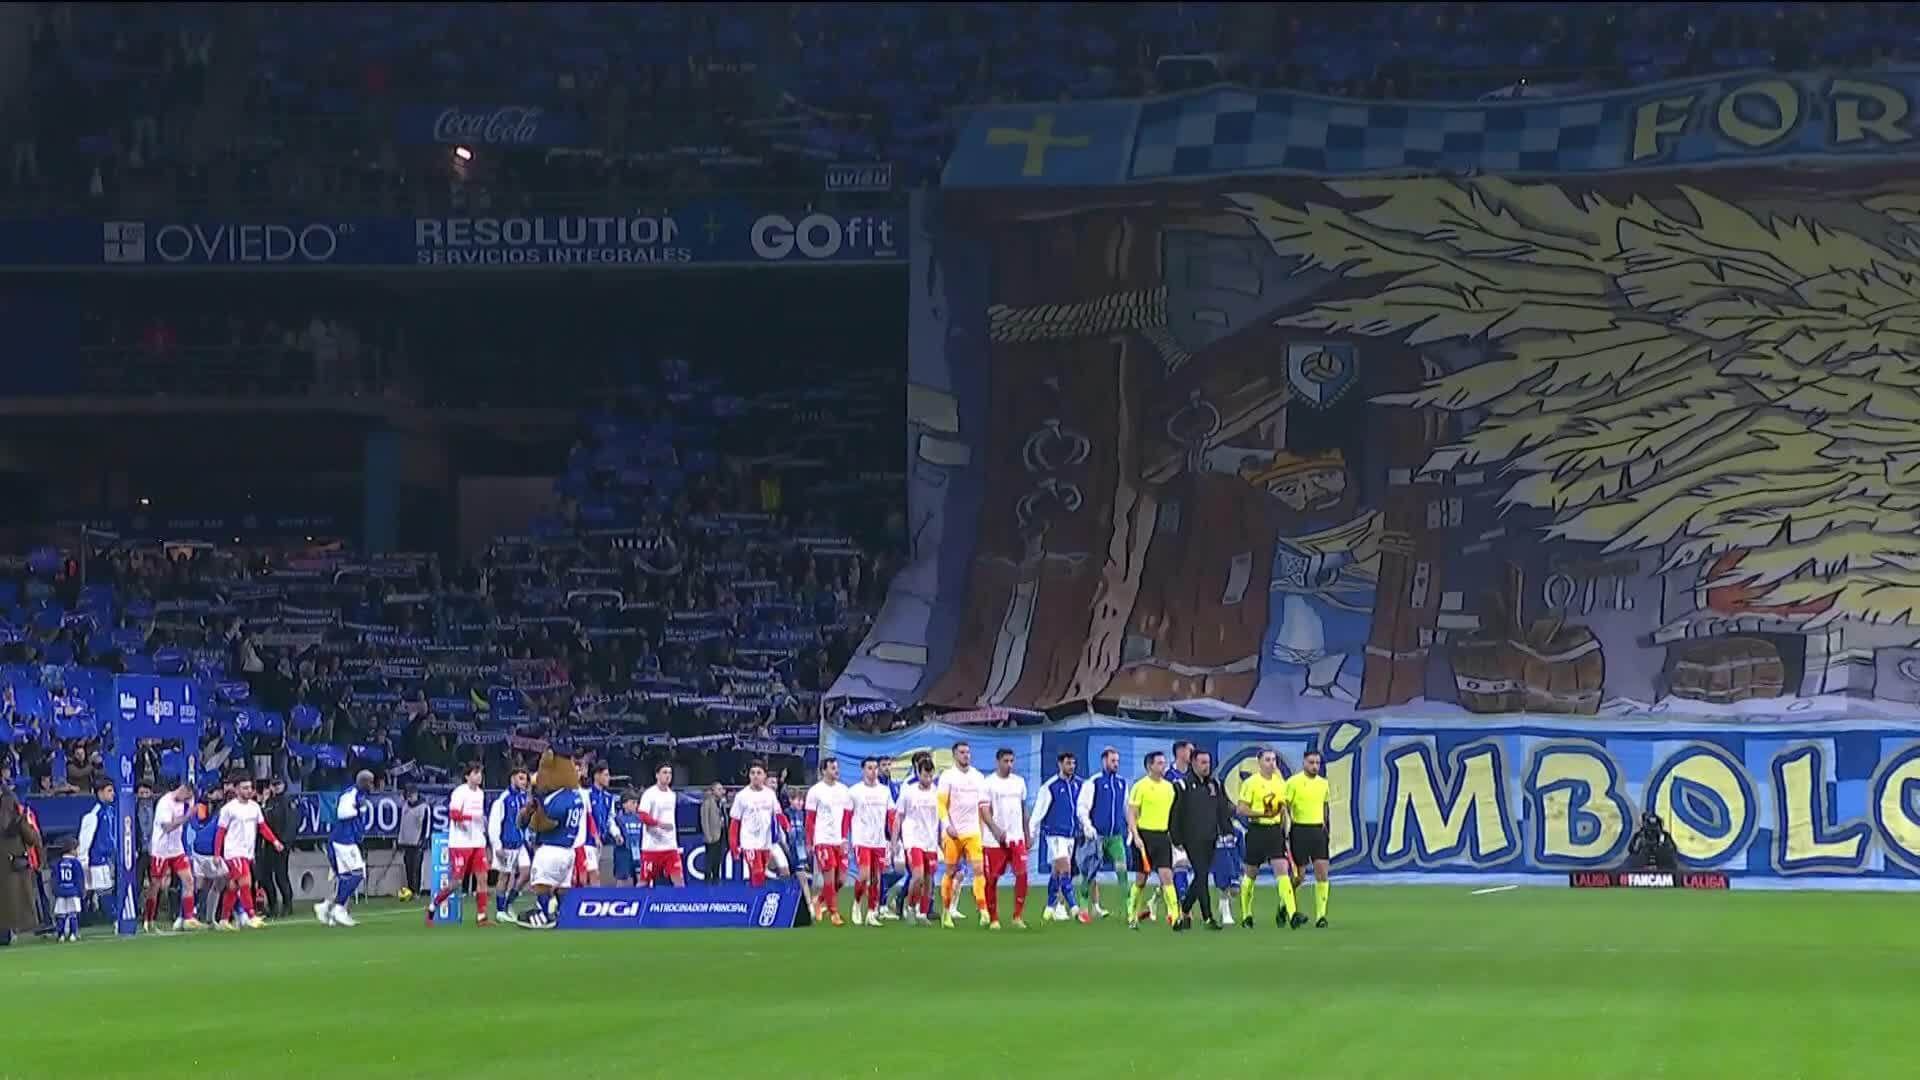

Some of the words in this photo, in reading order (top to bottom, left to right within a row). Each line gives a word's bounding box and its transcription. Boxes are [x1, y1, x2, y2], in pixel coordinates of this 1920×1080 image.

[1631, 78, 1913, 161] FOR
[156, 223, 337, 262] OVIEDO
[417, 248, 541, 264] SERVICIOS
[550, 248, 692, 264] INTEGRALES
[1619, 872, 1674, 888] #FANCAM
[1683, 873, 1726, 888] LALIGA
[578, 901, 640, 917] DIGI
[649, 902, 708, 914] PATROCINADOR
[709, 902, 748, 914] PRINCIPAL
